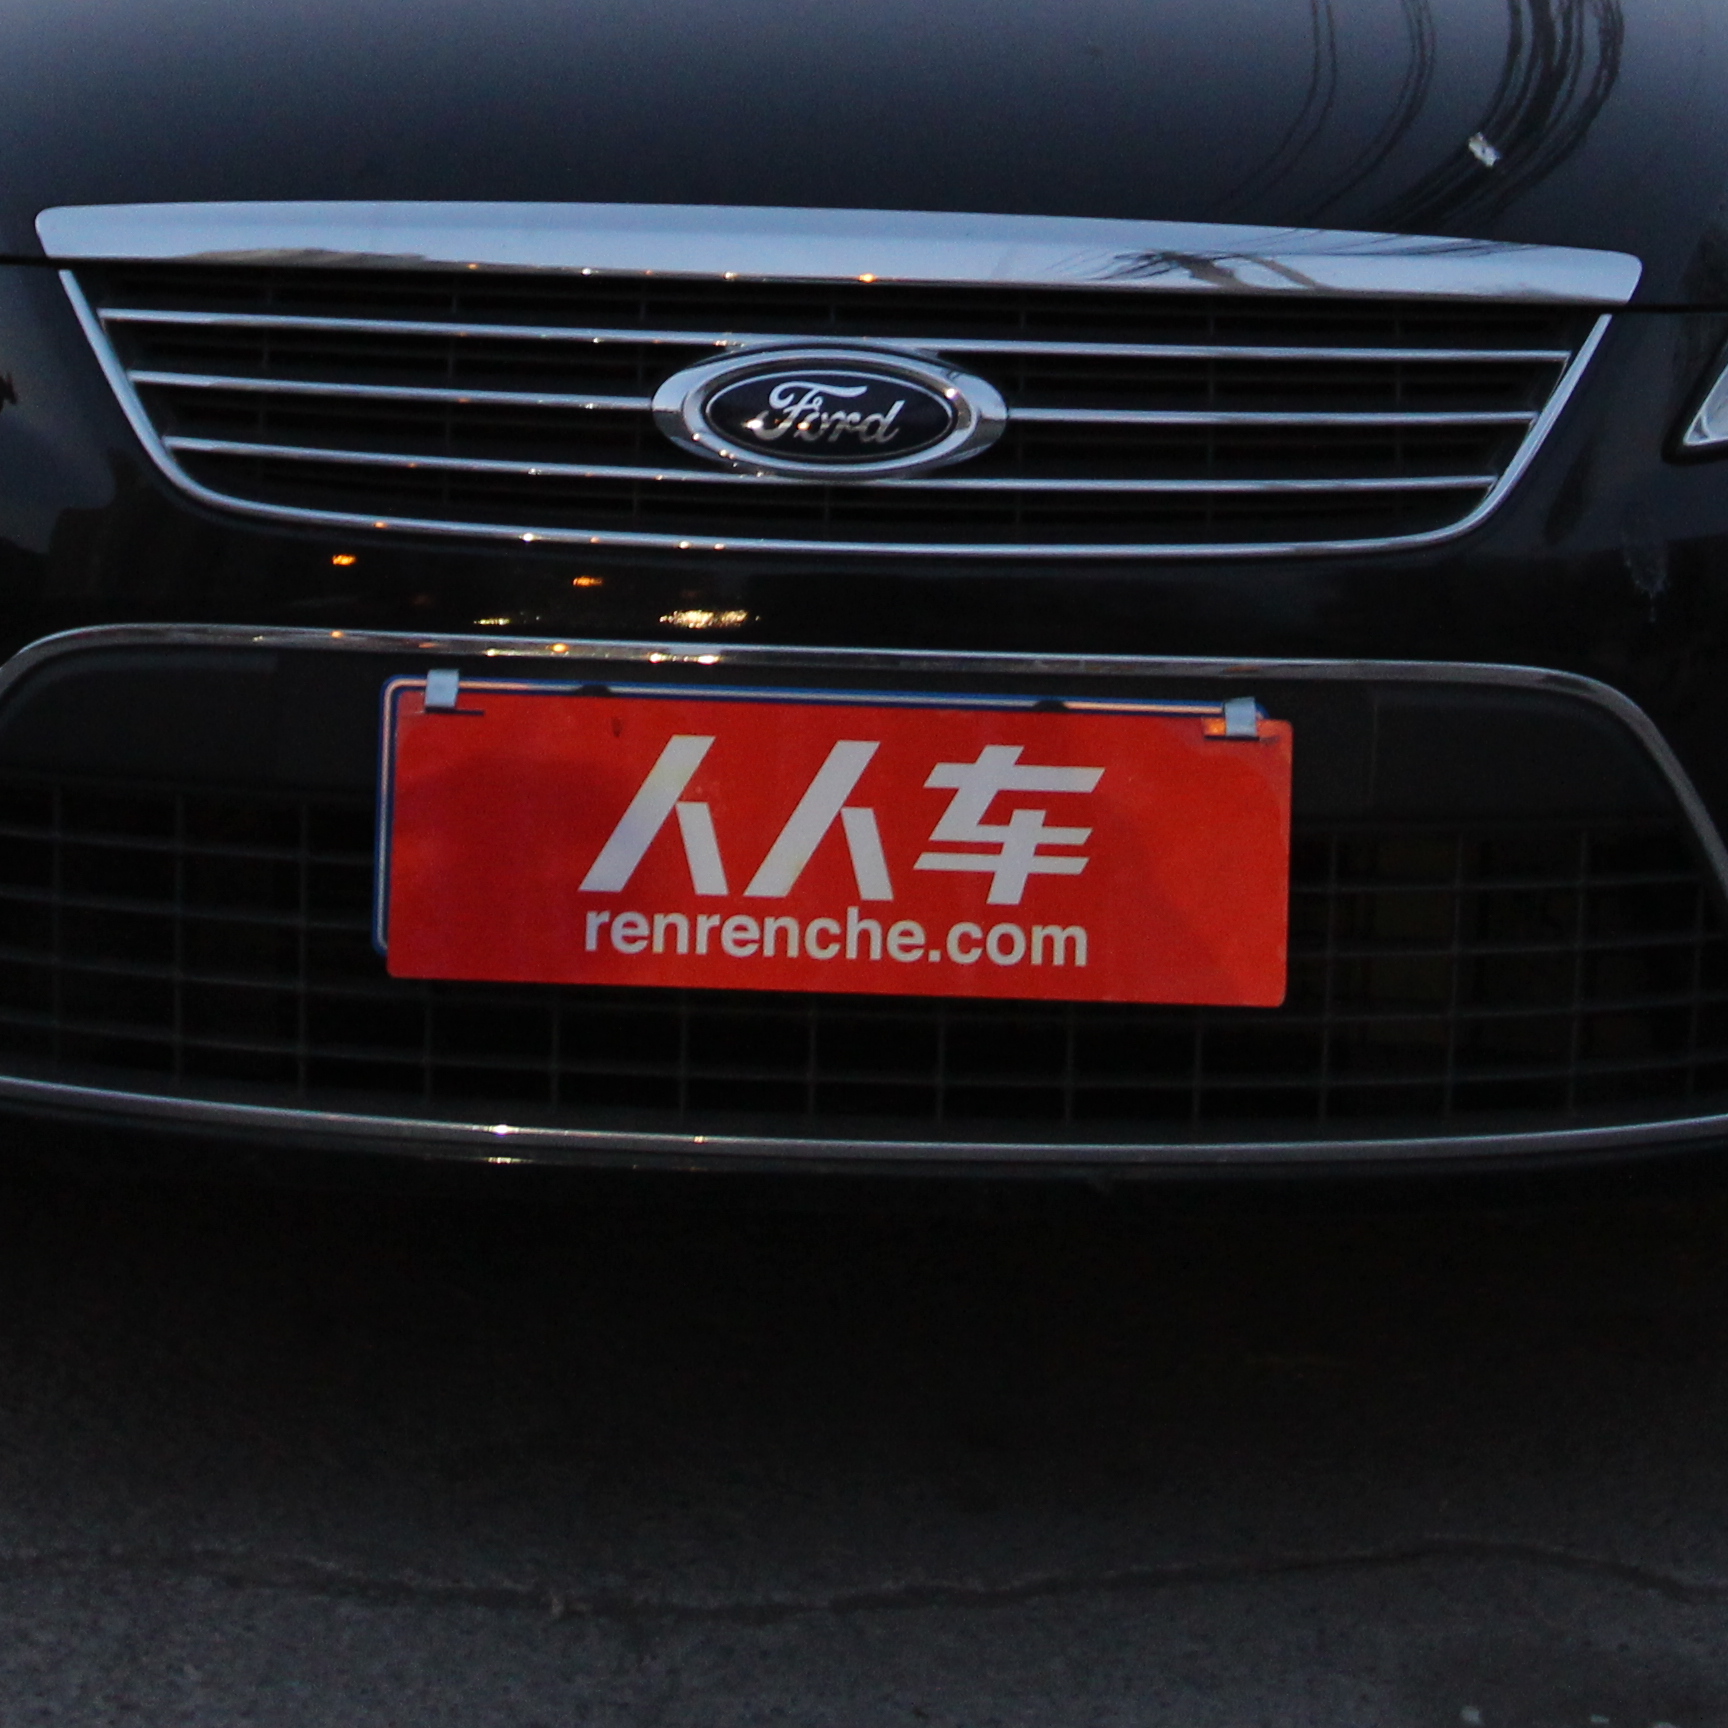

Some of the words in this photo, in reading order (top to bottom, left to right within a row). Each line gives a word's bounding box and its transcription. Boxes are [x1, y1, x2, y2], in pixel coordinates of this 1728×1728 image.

[744, 380, 906, 443] Ford
[579, 735, 1105, 905] 人人车
[586, 906, 1088, 966] renrenche.com
